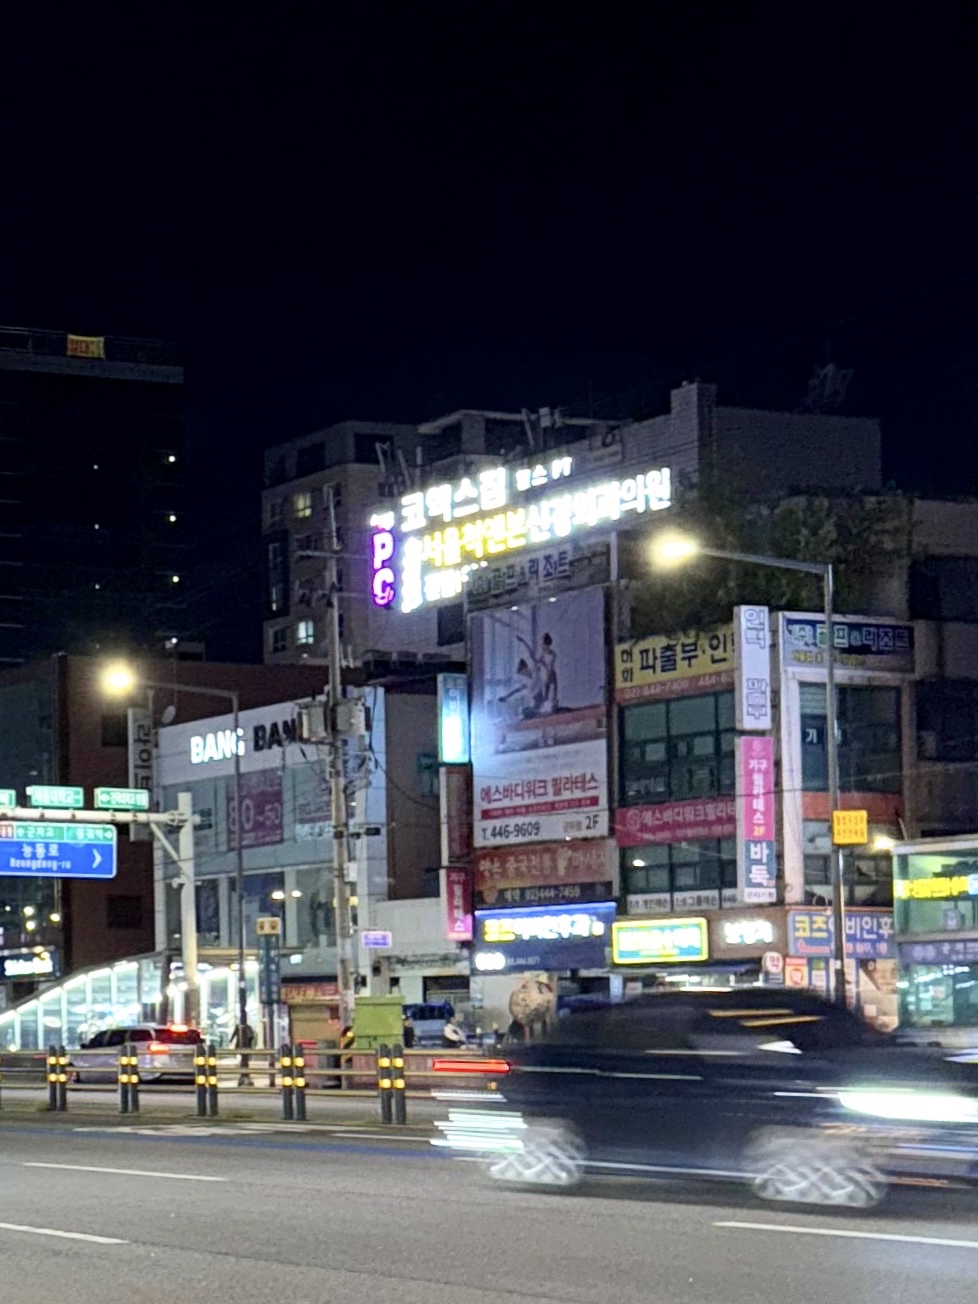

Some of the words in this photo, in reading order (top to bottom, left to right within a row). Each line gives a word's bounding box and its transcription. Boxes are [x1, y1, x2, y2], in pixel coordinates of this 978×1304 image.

[190, 728, 245, 764] BANG
[253, 717, 299, 752] BAN
[480, 779, 548, 805] 에스바디워크
[551, 773, 599, 797] 필라테스
